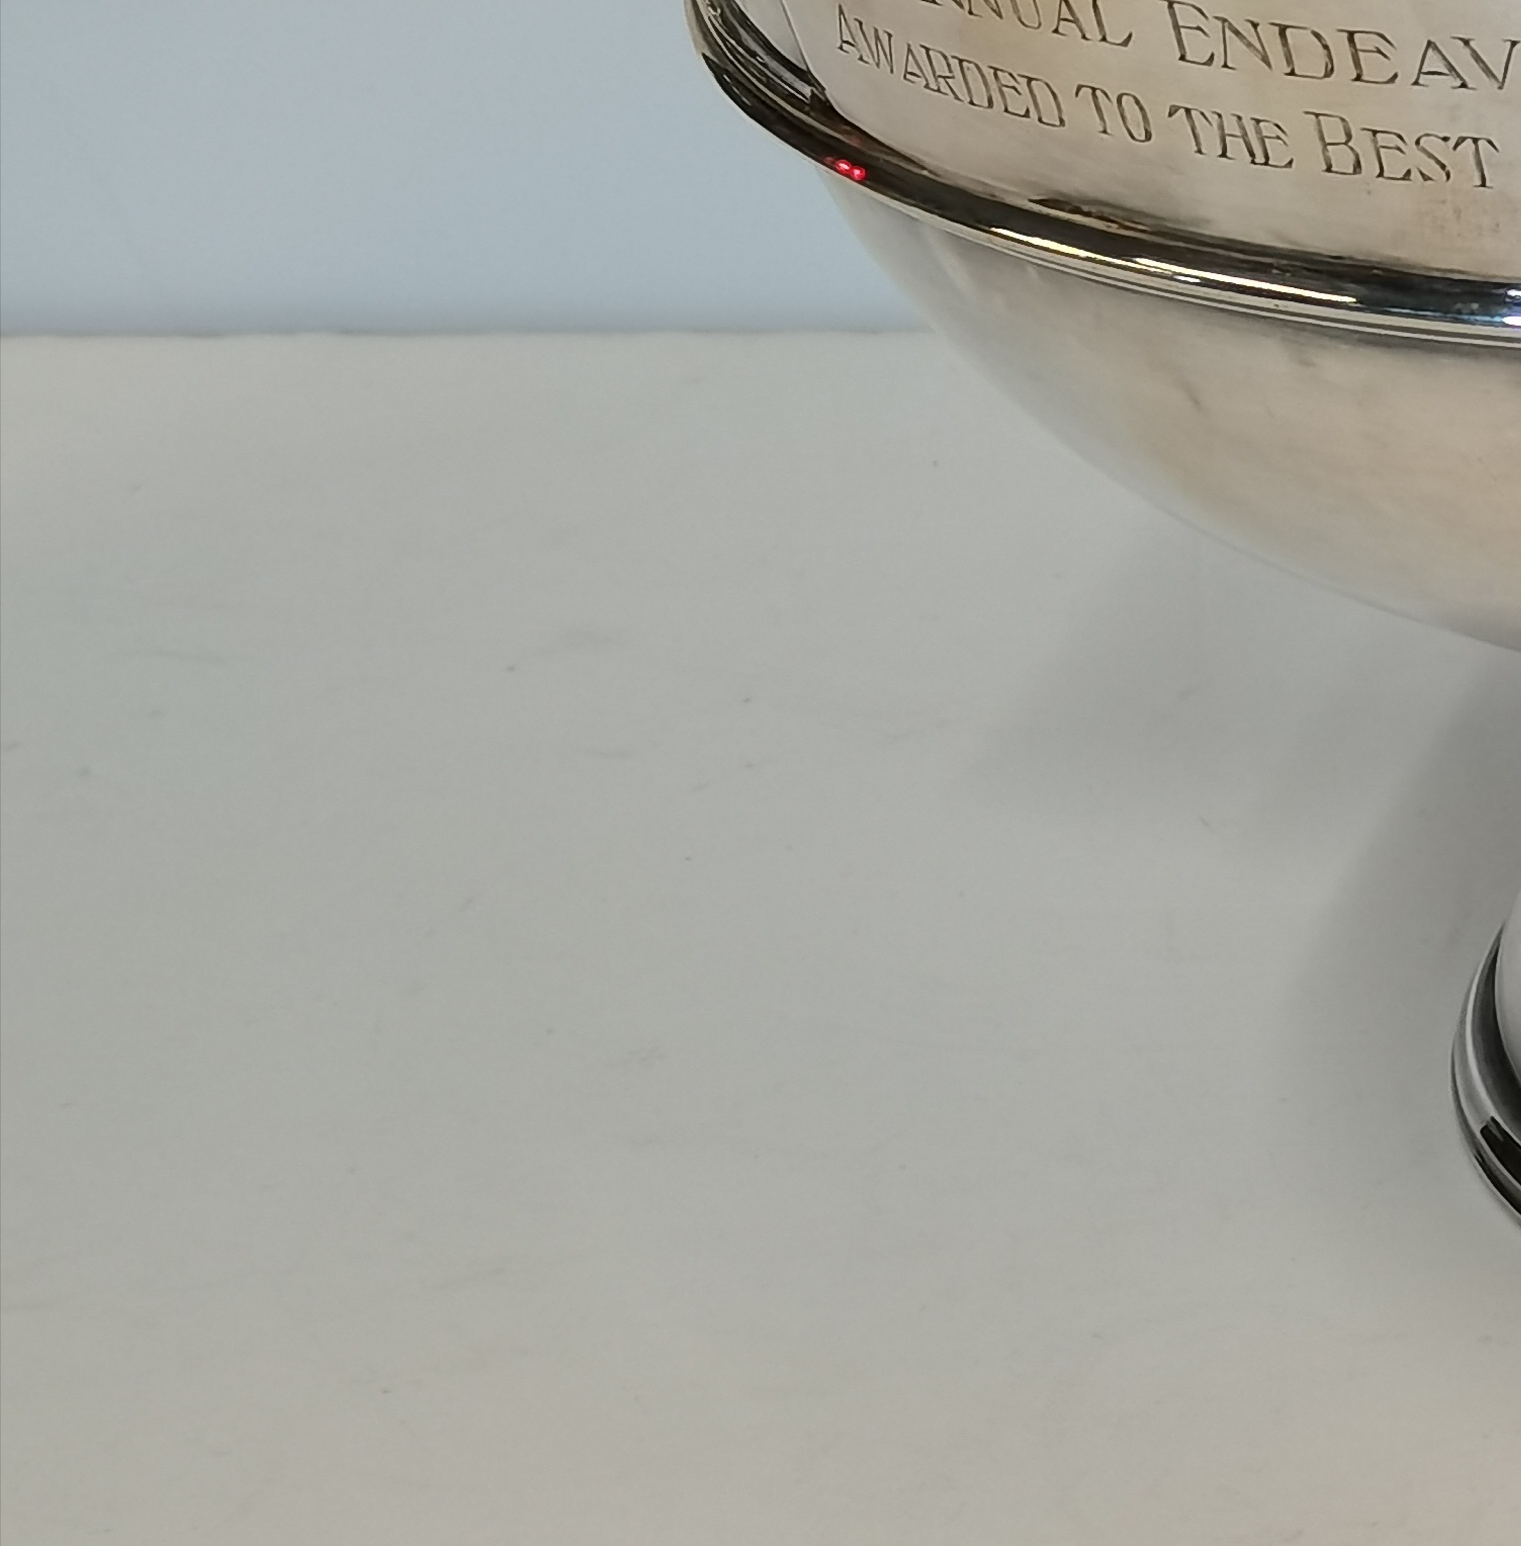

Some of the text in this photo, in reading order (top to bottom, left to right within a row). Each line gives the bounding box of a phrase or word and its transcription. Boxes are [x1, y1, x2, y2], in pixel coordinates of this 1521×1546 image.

[834, 2, 1066, 130] AWARDED
[1074, 82, 1153, 144] TO
[1167, 103, 1293, 170] THE
[1303, 109, 1499, 190] BEST
